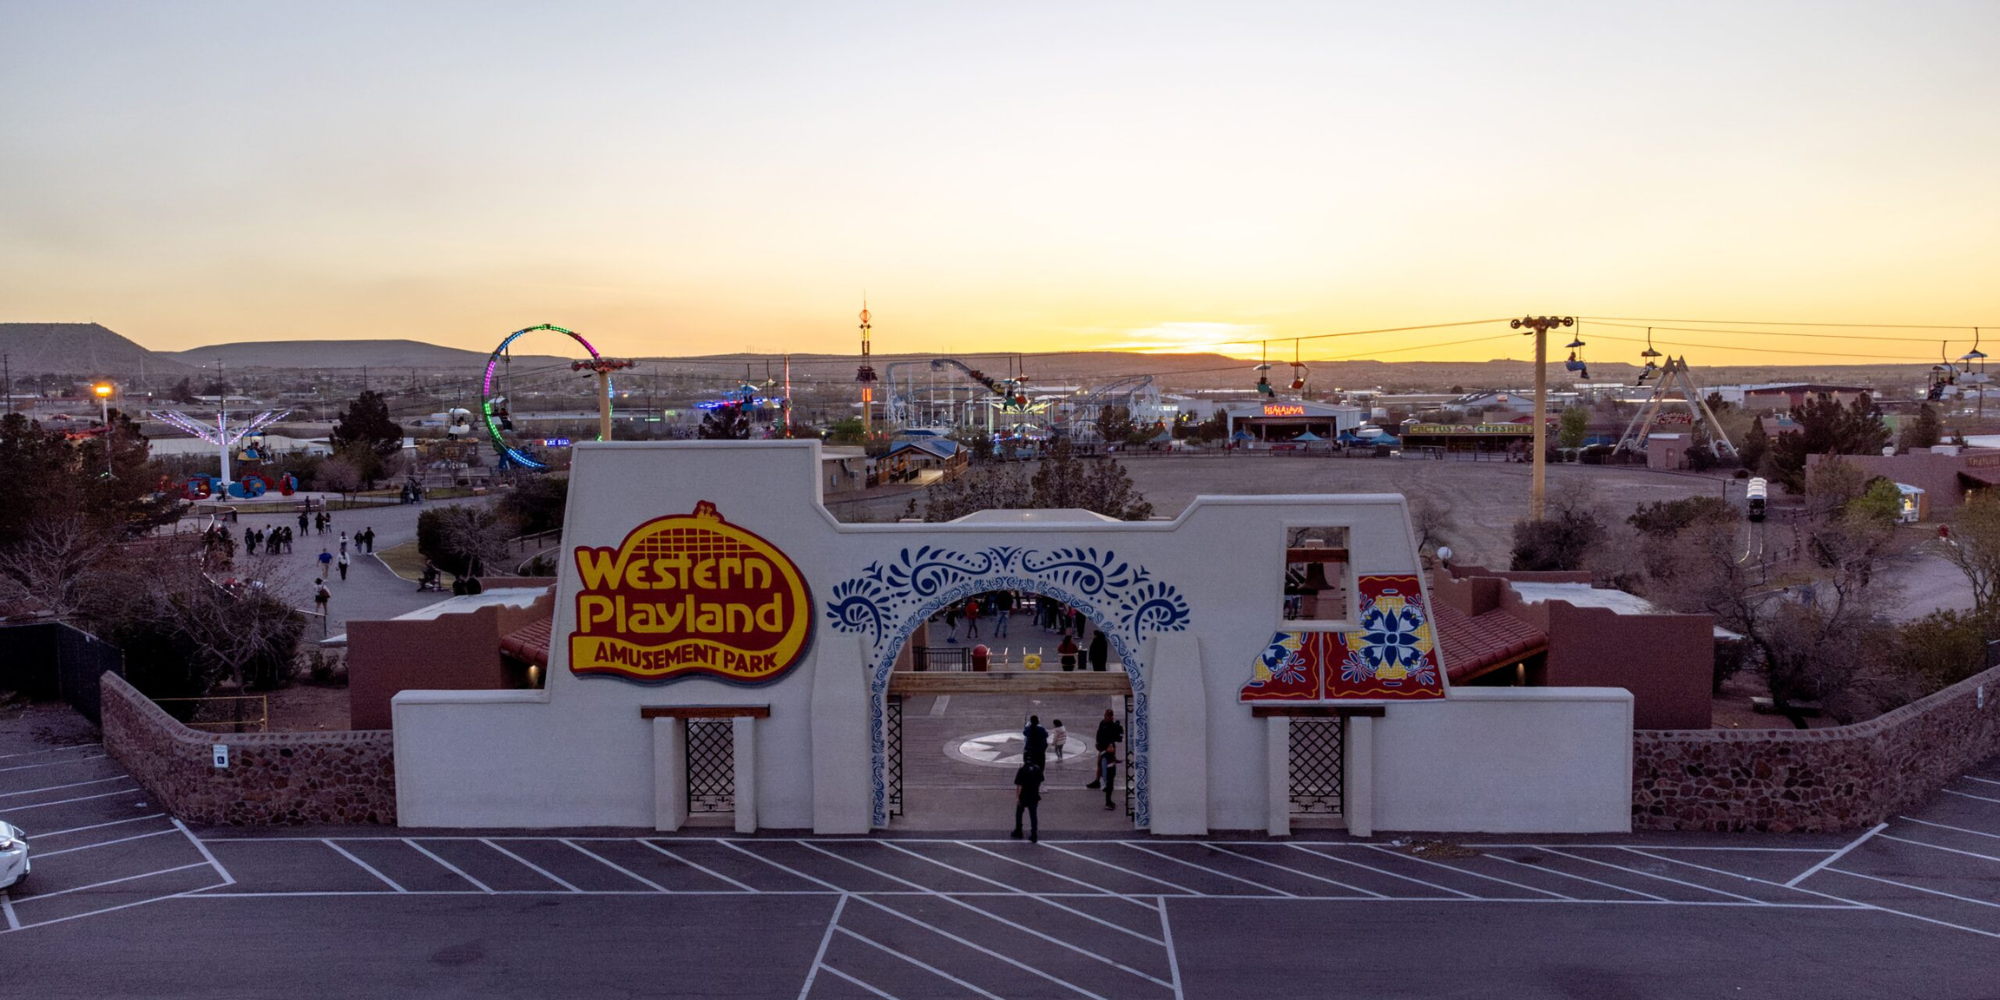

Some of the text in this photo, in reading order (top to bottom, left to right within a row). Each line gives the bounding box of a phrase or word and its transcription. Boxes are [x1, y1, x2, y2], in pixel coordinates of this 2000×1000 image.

[1411, 425, 1452, 434] CACTUS
[577, 550, 773, 590] Western
[579, 593, 784, 633] Playland
[594, 641, 778, 673] AMUSEMENT PARK
